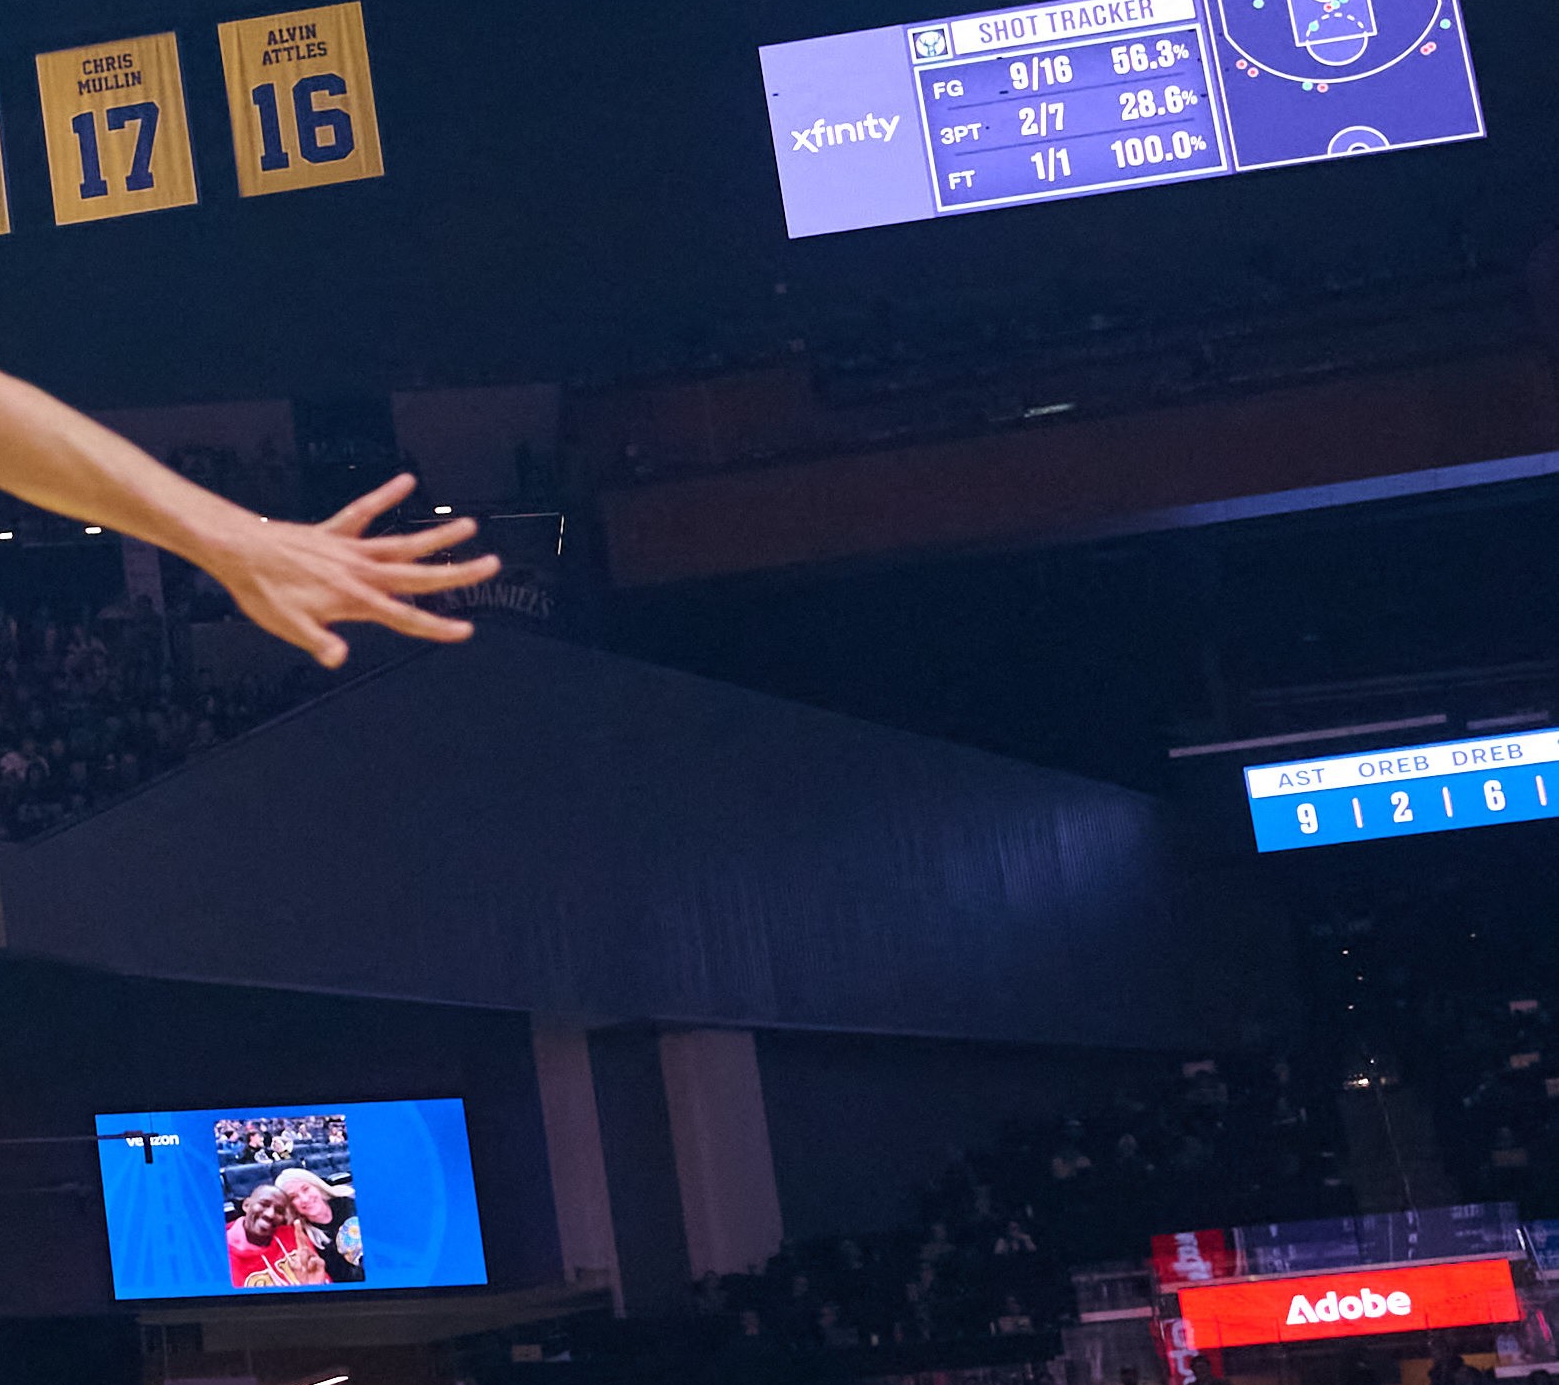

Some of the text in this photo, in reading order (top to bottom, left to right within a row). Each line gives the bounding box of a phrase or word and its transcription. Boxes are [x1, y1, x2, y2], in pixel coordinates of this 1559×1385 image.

[266, 23, 317, 46] ALVIN
[979, 15, 1038, 43] SHOT
[82, 53, 134, 75] CHRIS
[261, 42, 328, 67] ATTLES
[933, 39, 1190, 99] FG 9/16 56.3%
[77, 70, 143, 96] MULLIN
[252, 73, 356, 172] 16
[790, 112, 900, 153] xfinity
[940, 85, 1198, 145] 3PT 2/7 28.6%
[72, 101, 160, 200] 17
[948, 131, 1207, 190] FT 1/1 100.0%
[1278, 743, 1523, 789] AST OREB DREB
[1296, 779, 1506, 834] 9 2 6
[125, 1135, 180, 1147] veizon
[1286, 1288, 1411, 1325] Adobe
